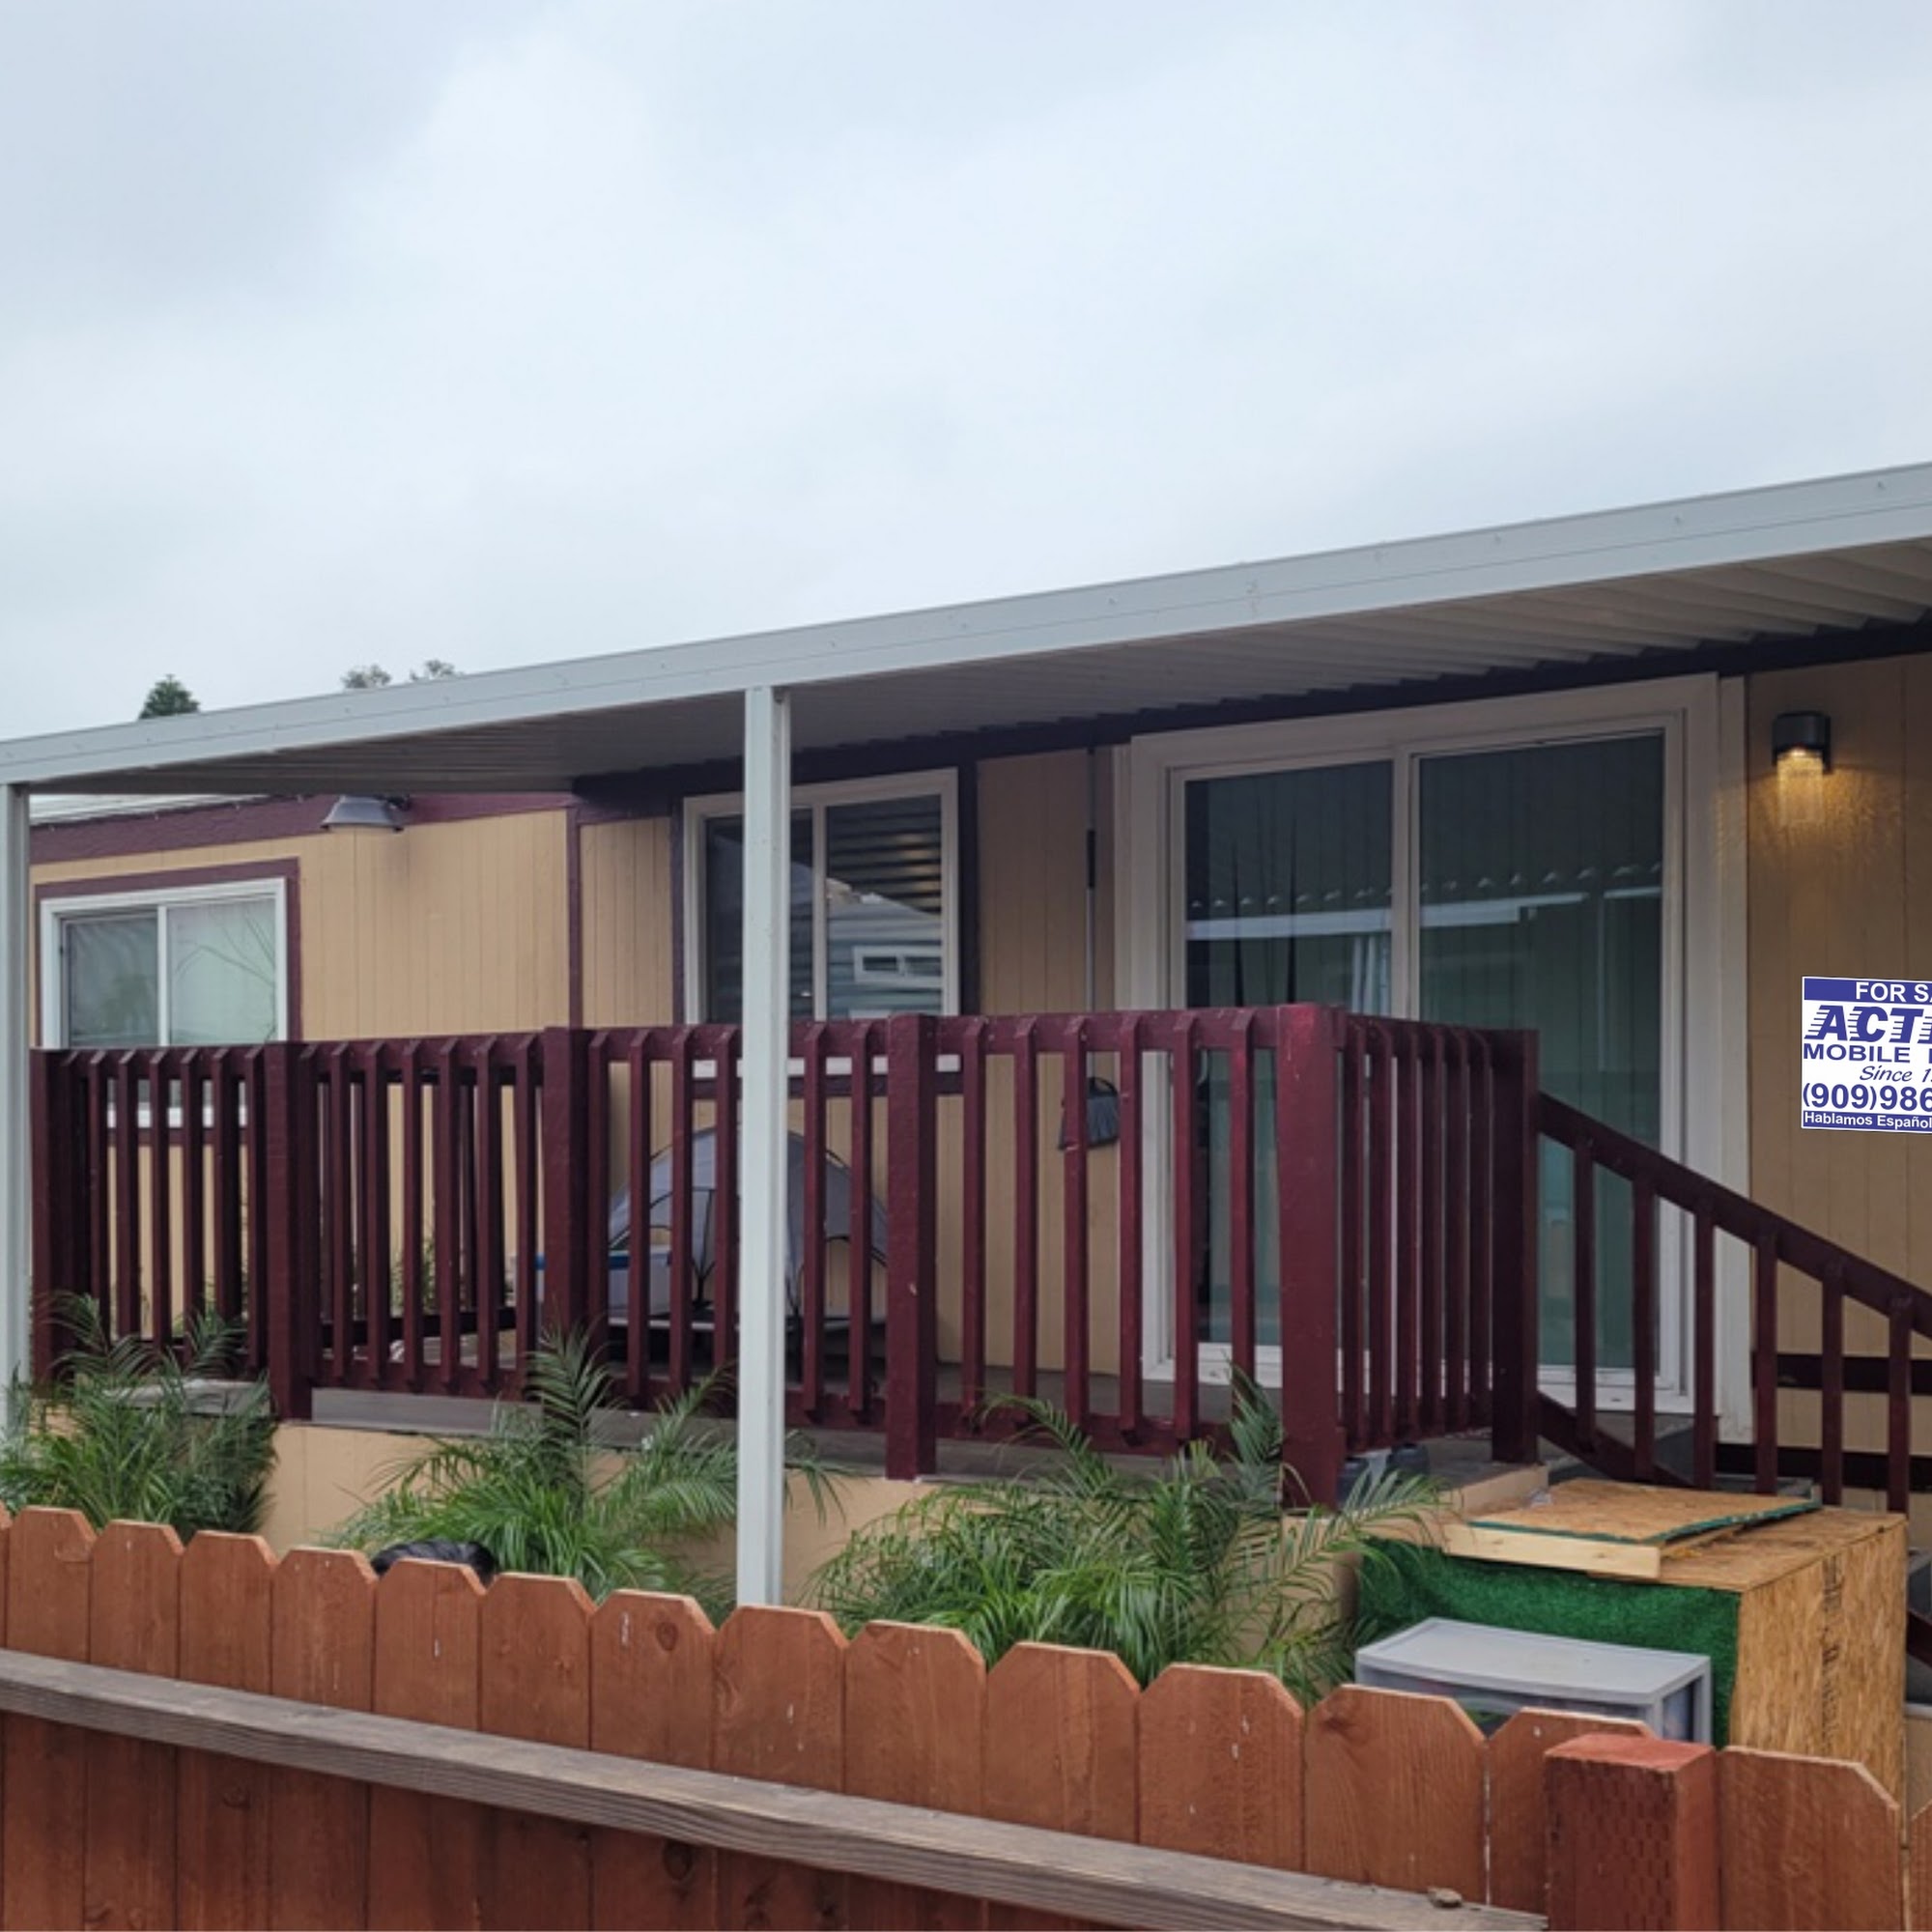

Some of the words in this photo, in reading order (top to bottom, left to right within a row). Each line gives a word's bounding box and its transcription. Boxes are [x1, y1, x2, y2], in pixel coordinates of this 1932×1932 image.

[1856, 981, 1906, 1003] FOR
[1914, 983, 1932, 1003] S
[1804, 1043, 1911, 1064] MOBILE
[1860, 1065, 1913, 1082] Since
[1921, 1067, 1932, 1083] 1
[1803, 1083, 1932, 1112] (909)986
[1804, 1112, 1873, 1125] Hablamos
[1877, 1115, 1932, 1130] Español
